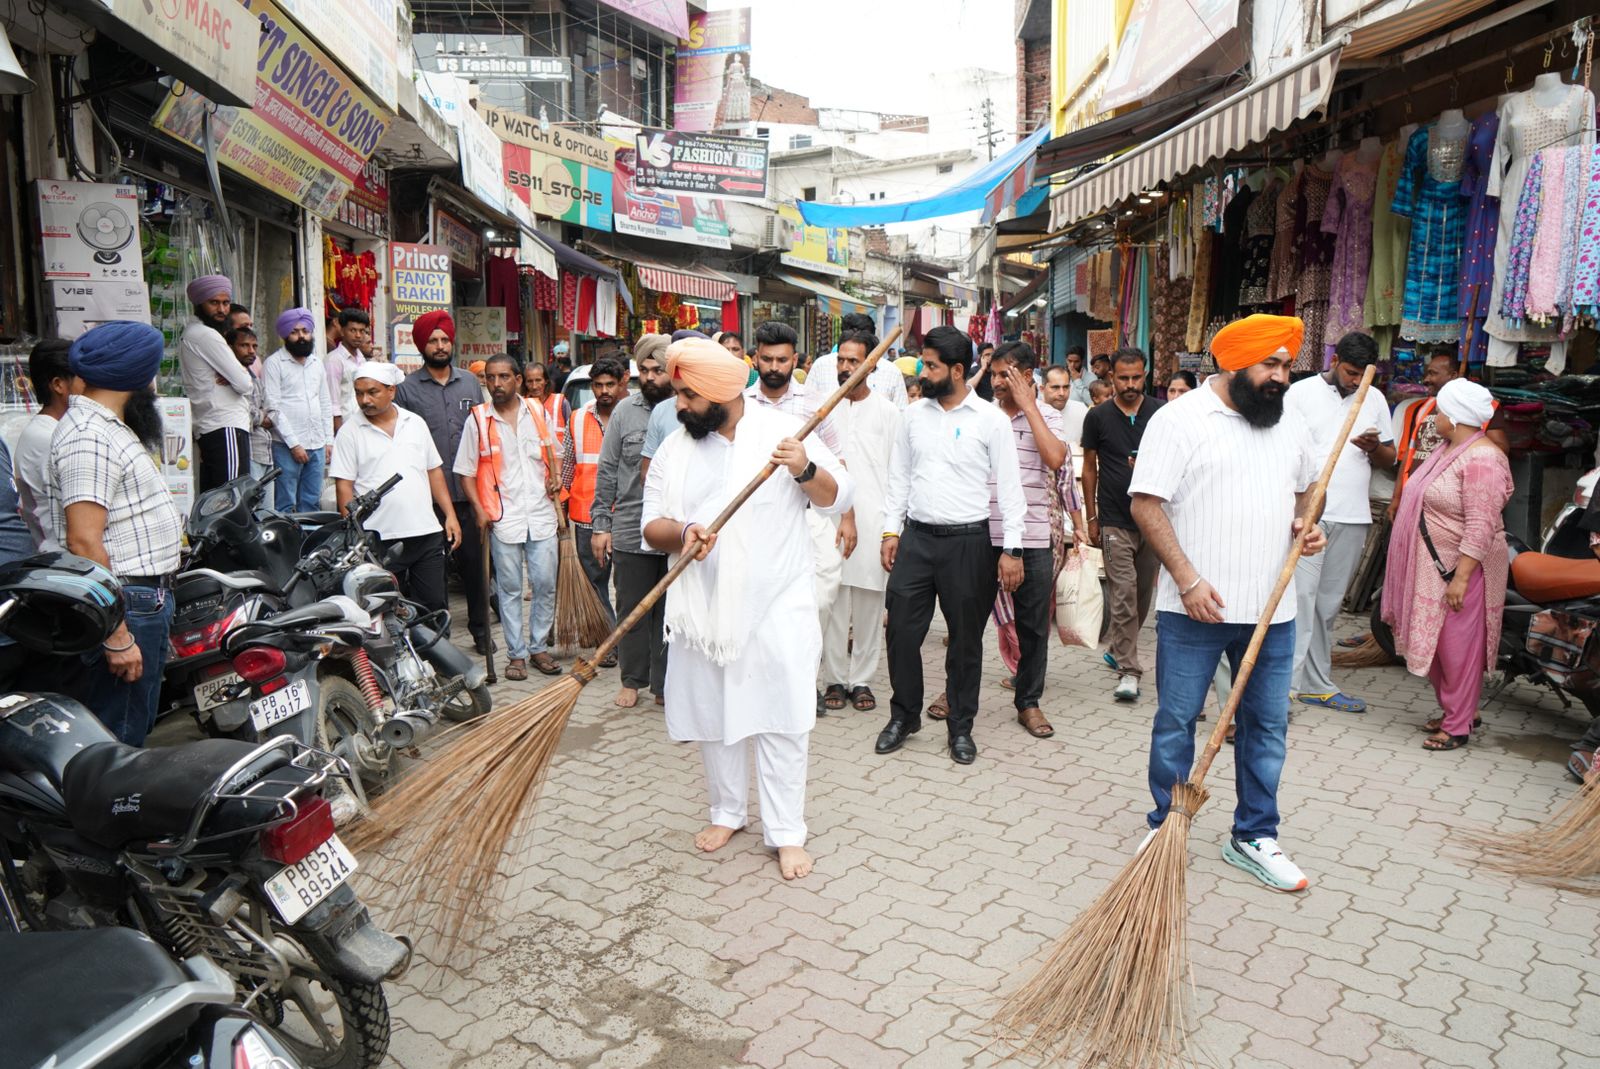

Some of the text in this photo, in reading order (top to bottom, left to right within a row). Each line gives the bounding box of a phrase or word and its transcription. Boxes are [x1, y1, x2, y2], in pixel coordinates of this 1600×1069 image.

[185, 0, 232, 50] MARC
[436, 58, 563, 73] VS Fashion Hub
[271, 42, 341, 118] SINGH
[326, 89, 352, 128] &
[232, 118, 262, 147] GSTIN:
[338, 102, 385, 156] SONS
[485, 109, 609, 162] JP WATCH & OPTICALS
[637, 133, 673, 168] VS
[672, 146, 765, 169] FASHION HUB
[508, 169, 603, 206] 5911_STORE
[630, 205, 658, 220] Anchor
[393, 246, 449, 271] Prince
[62, 287, 94, 295] VIBE
[396, 271, 446, 287] FANCY
[397, 286, 445, 302] RAKHI
[461, 343, 503, 355] JP WATCH
[261, 685, 299, 711] PB 16
[265, 698, 301, 724] F4917
[298, 857, 350, 908] B9544
